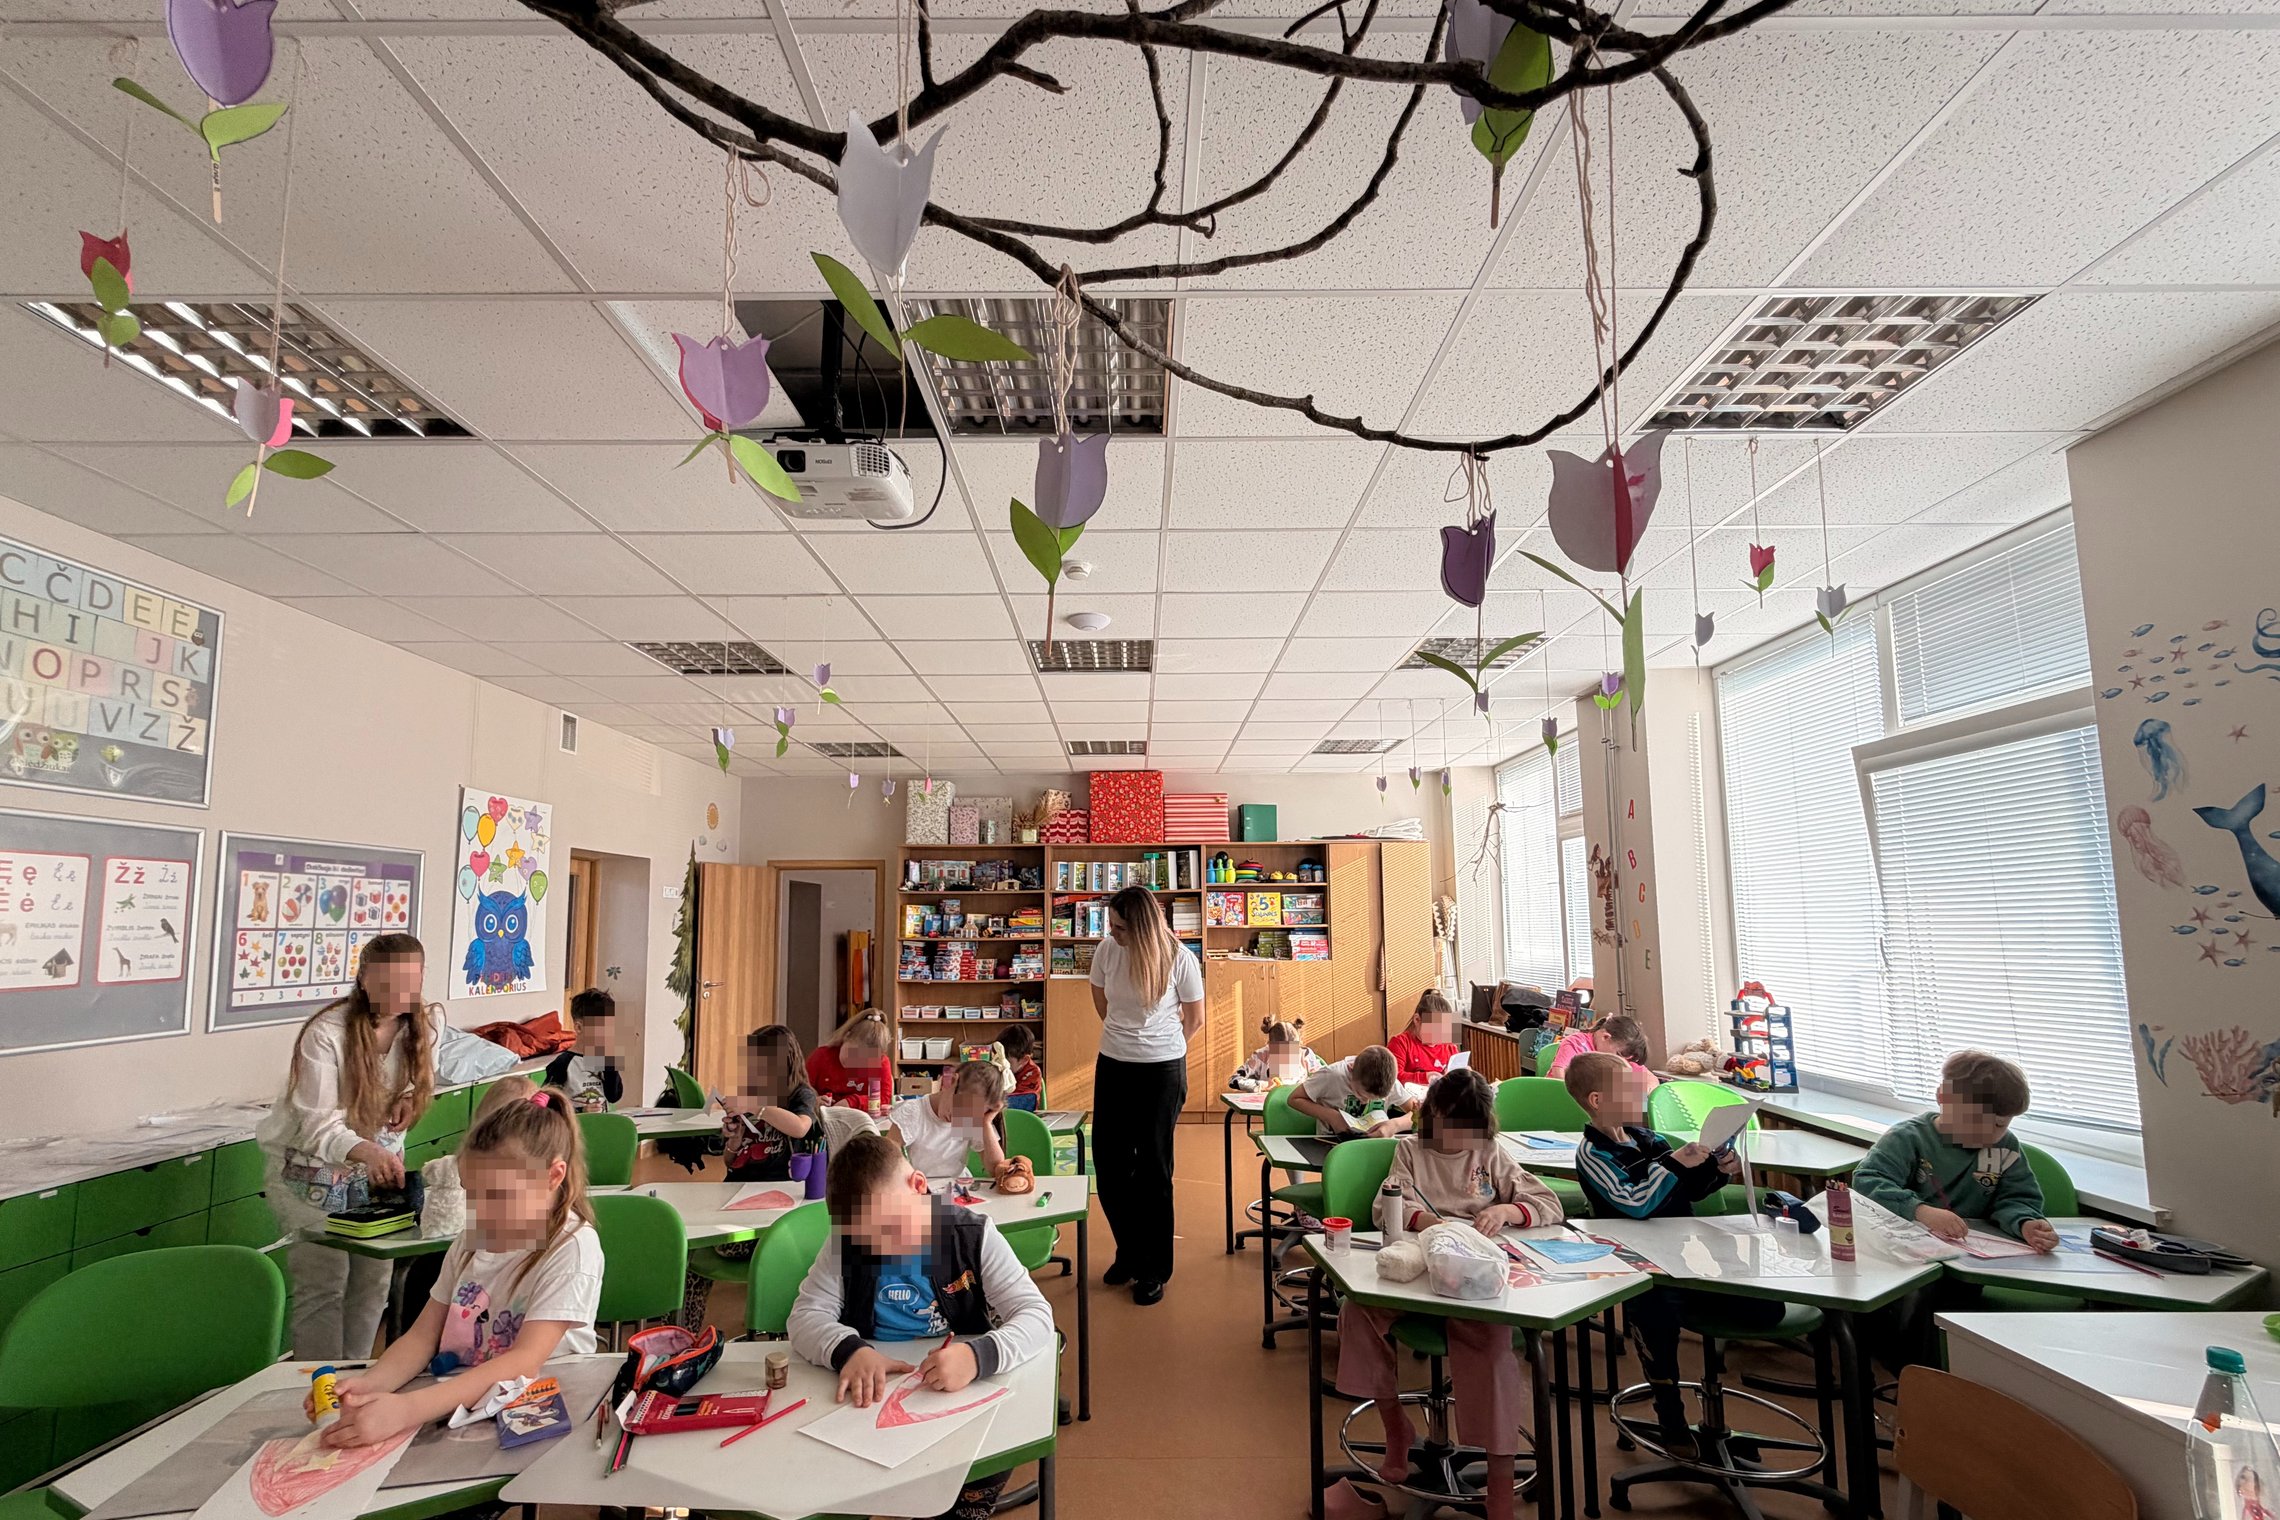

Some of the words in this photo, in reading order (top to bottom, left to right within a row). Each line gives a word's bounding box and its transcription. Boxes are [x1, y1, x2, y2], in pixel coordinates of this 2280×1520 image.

[0, 552, 27, 584] C
[46, 563, 72, 603] Č
[89, 579, 113, 610] D
[134, 593, 152, 624] E
[171, 604, 190, 638] Ė
[13, 598, 40, 633] H
[65, 613, 80, 644] I
[146, 637, 162, 664] J
[180, 646, 199, 676] K
[33, 648, 62, 679] O
[80, 659, 101, 687] P
[121, 669, 141, 699] R
[100, 703, 122, 733] V
[139, 712, 161, 741] Z
[176, 715, 196, 752] Ž
[1628, 799, 1634, 819] A
[1627, 849, 1637, 870] B
[243, 873, 249, 886] 1
[283, 876, 291, 888] 2
[319, 878, 326, 889] 3
[354, 880, 361, 891] 4
[386, 882, 392, 892] 5
[1639, 882, 1645, 903] C
[1259, 897, 1269, 910] 5
[238, 933, 247, 946] 6
[278, 933, 286, 945] 7
[315, 932, 323, 945] 8
[350, 932, 357, 944] 9
[1645, 949, 1650, 970] E
[259, 992, 264, 1001] 2
[279, 991, 283, 999] 3
[297, 990, 302, 998] 4
[315, 989, 320, 997] 5
[333, 987, 337, 995] 6
[889, 1290, 911, 1301] HELLO
